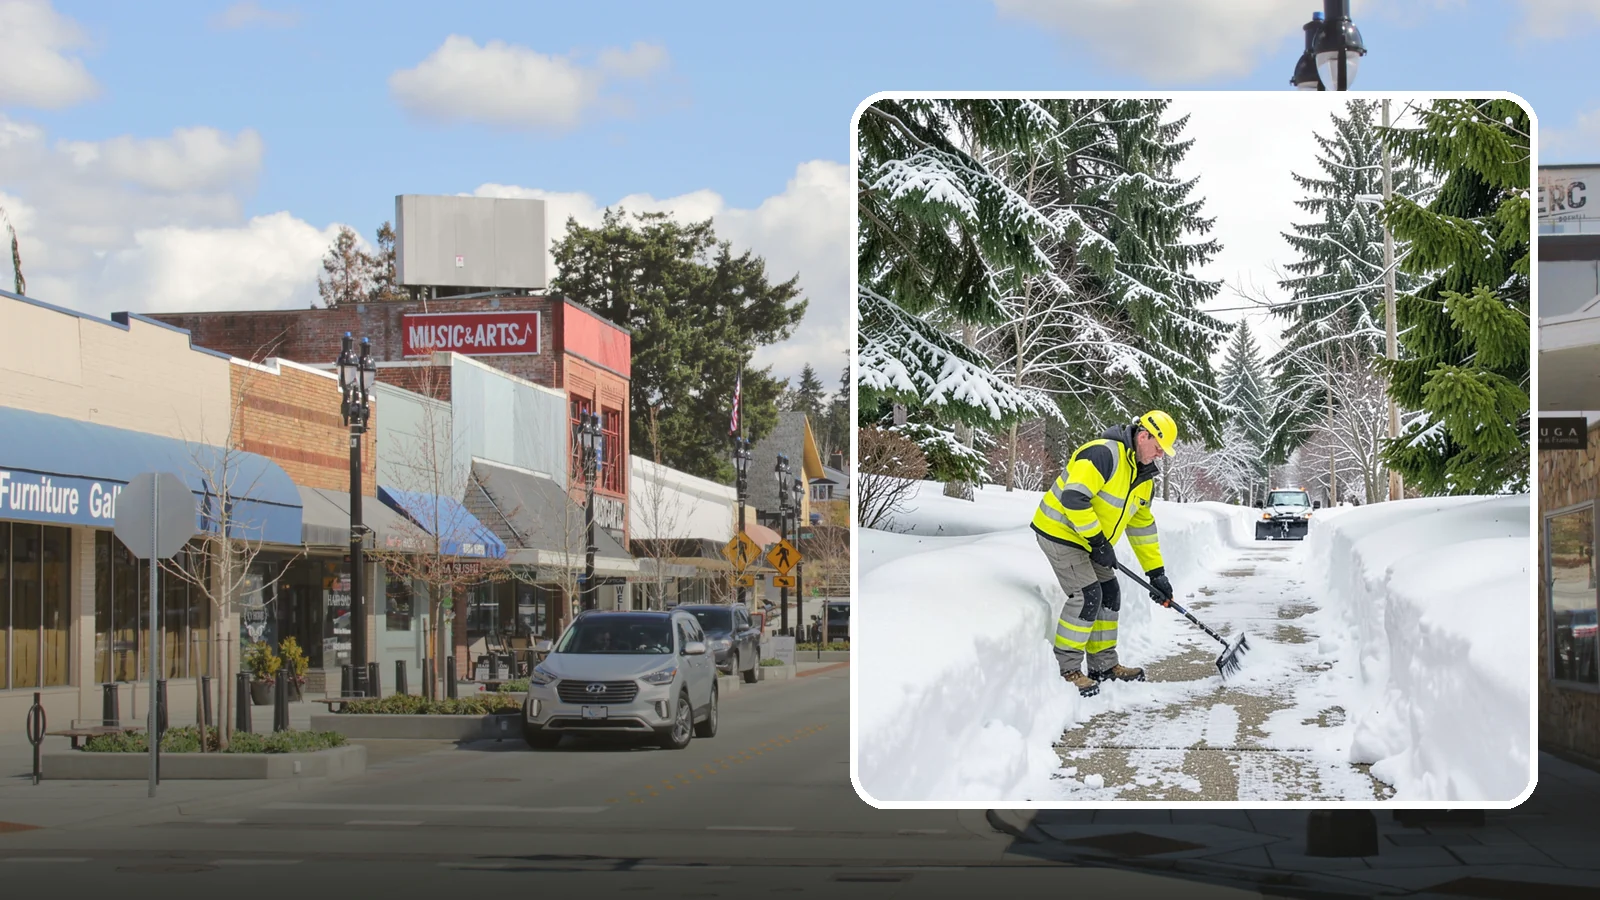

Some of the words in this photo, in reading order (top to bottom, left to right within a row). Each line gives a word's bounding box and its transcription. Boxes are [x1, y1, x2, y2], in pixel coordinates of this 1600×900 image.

[1541, 427, 1577, 437] UGA
[0, 471, 79, 515] Furniture
[89, 482, 122, 519] Gal
[453, 563, 479, 574] SUSHI
